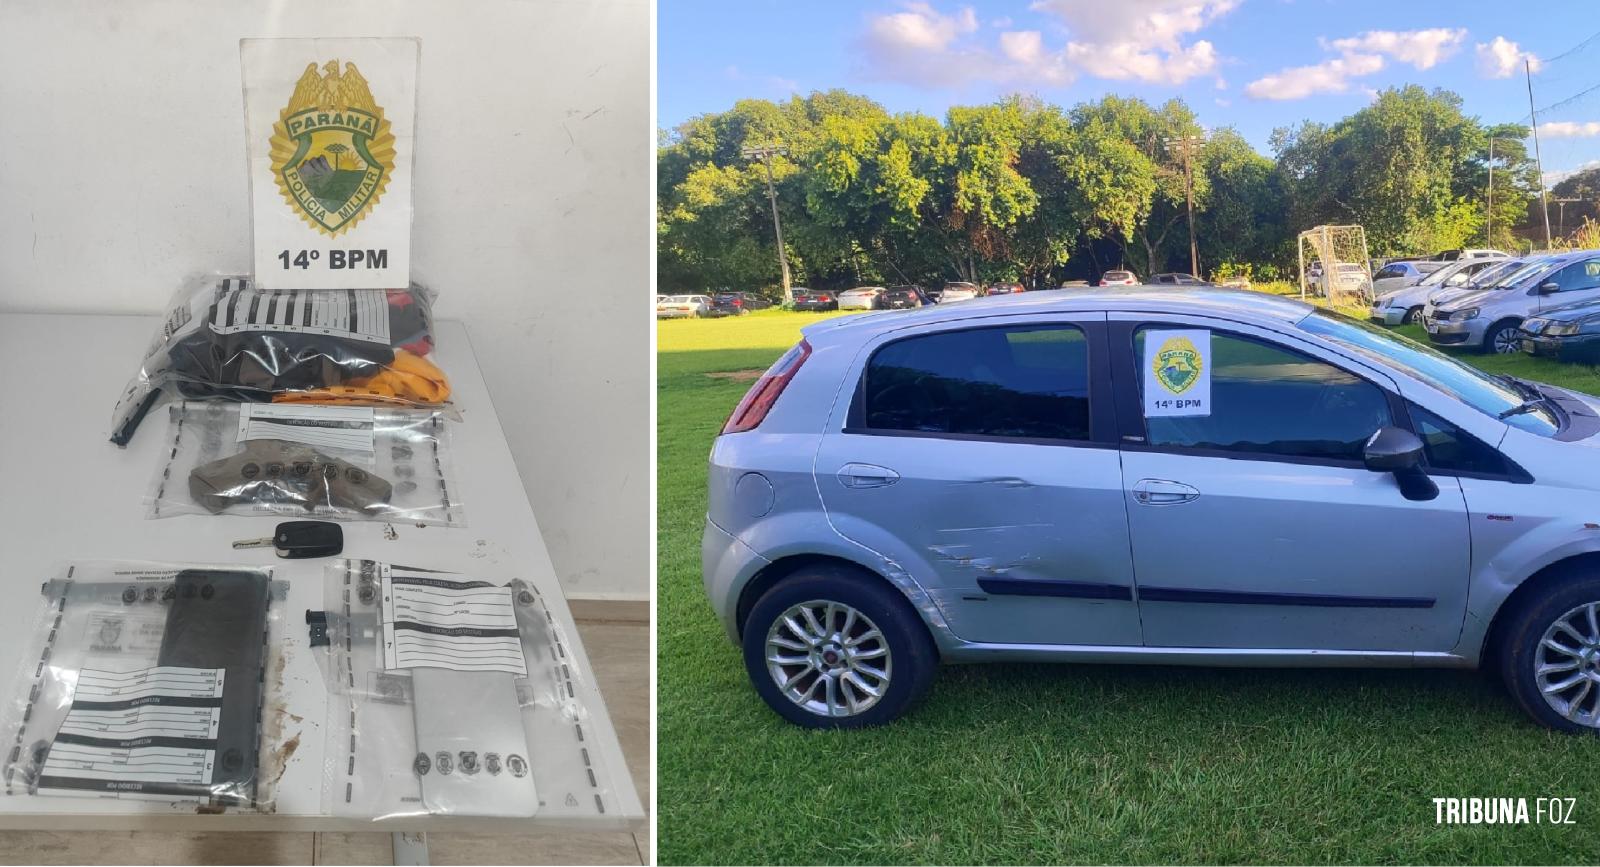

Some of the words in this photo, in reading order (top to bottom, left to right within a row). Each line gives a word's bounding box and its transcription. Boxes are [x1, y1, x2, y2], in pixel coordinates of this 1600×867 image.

[290, 112, 374, 134] PARANÁ
[287, 171, 326, 221] POLÍCIA
[338, 171, 377, 220] MILITAR
[278, 249, 320, 269] 14º
[329, 249, 388, 269] BPM
[1176, 400, 1201, 408] BPM
[118, 782, 143, 790] RECEBIDO
